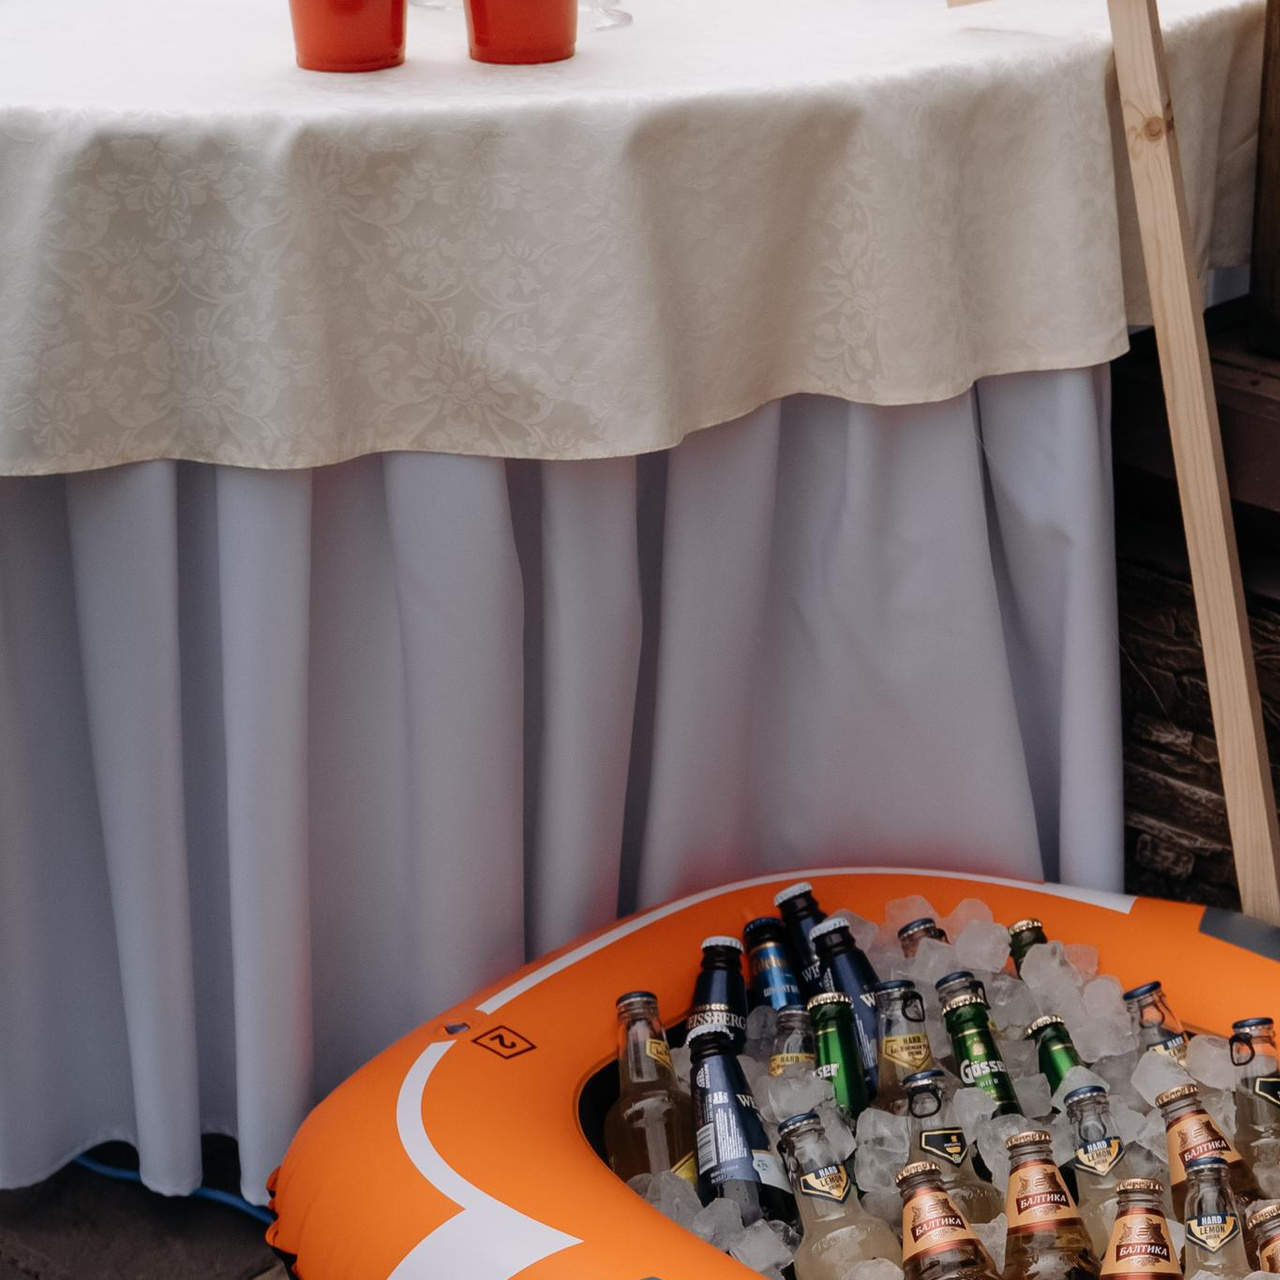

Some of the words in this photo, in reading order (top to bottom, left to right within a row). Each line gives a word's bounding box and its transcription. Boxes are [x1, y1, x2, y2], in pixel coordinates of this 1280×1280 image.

[1167, 1035, 1184, 1051] HARD
[1086, 1140, 1108, 1153] HARD
[1184, 1140, 1227, 1163] БАЛТИКА
[1087, 1149, 1112, 1163] LEMON
[818, 1165, 838, 1178] HARD
[819, 1174, 844, 1188] LEMON
[1020, 1192, 1067, 1210] БАЛТИКА
[915, 1216, 962, 1237] БАЛТИКА
[1201, 1215, 1223, 1225] HARD
[1200, 1225, 1226, 1235] LEMON
[1119, 1244, 1168, 1258] БАЛТИКА
